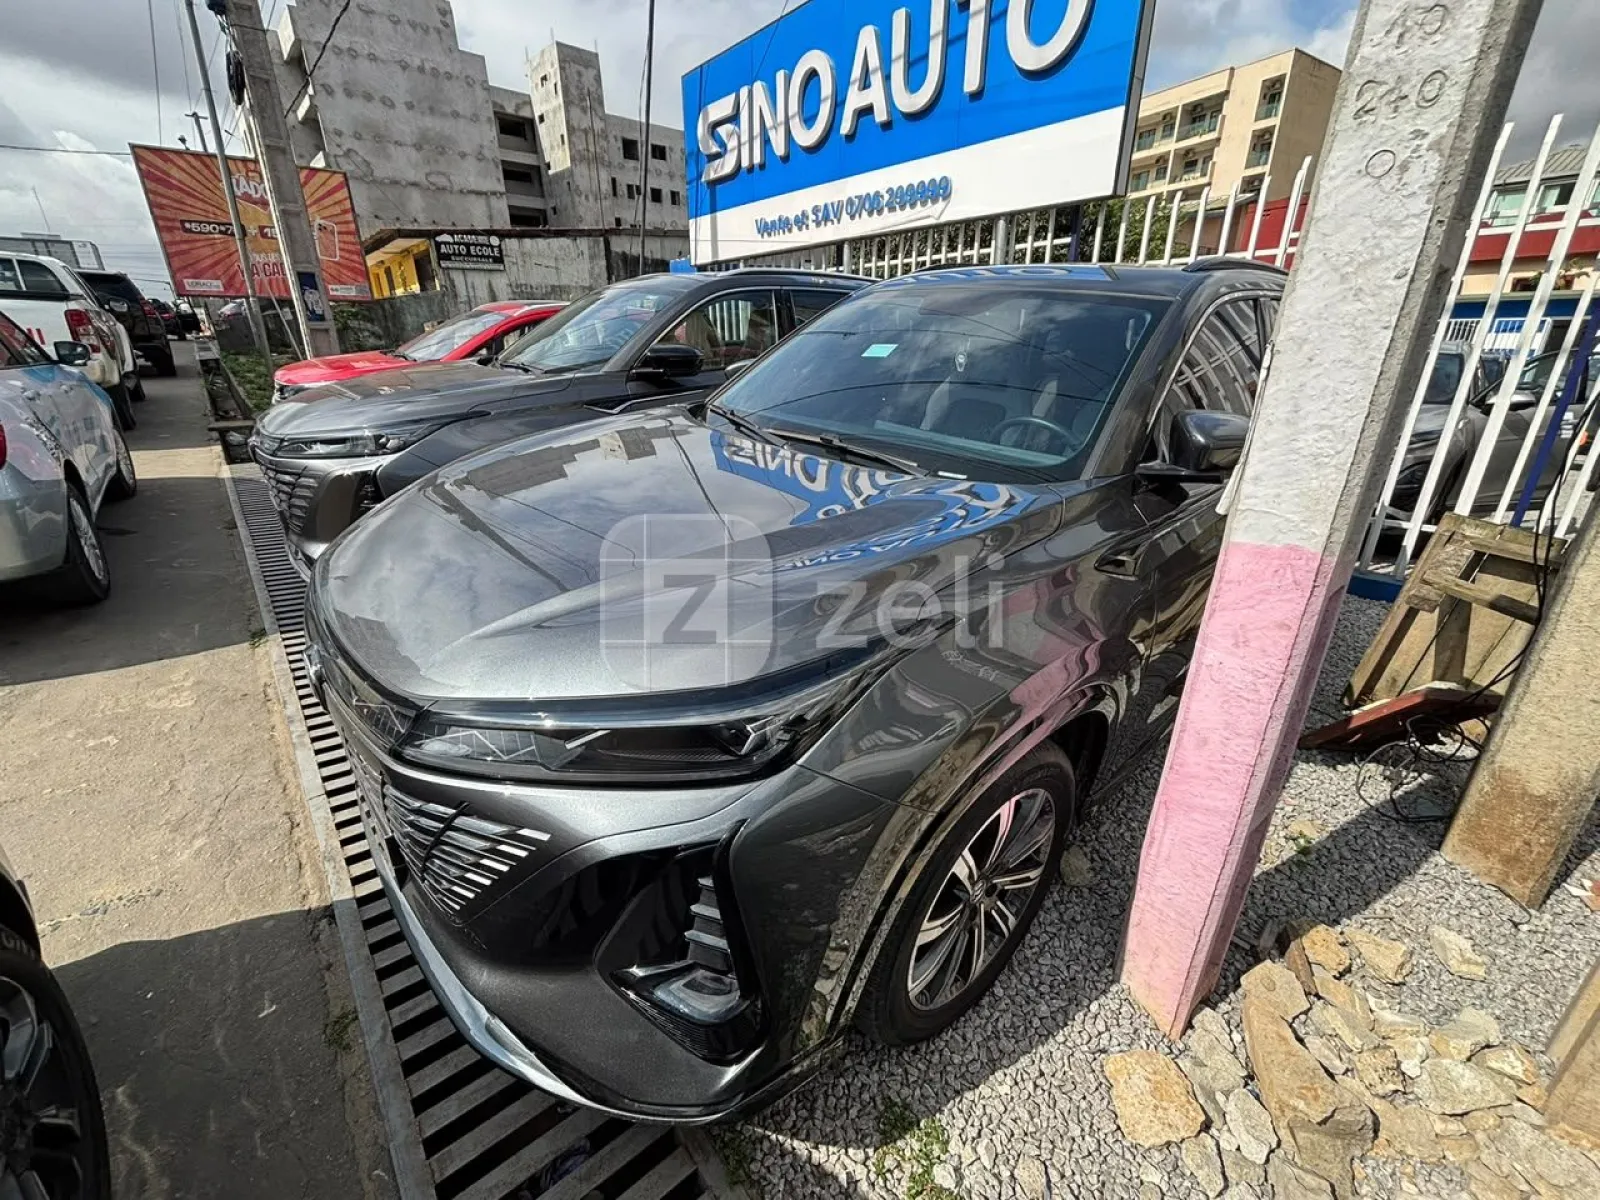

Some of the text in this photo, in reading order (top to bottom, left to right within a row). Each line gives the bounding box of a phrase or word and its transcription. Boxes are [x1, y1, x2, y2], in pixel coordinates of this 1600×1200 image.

[812, 200, 844, 227] SAV
[440, 244, 500, 257] AUTO ECOLE
